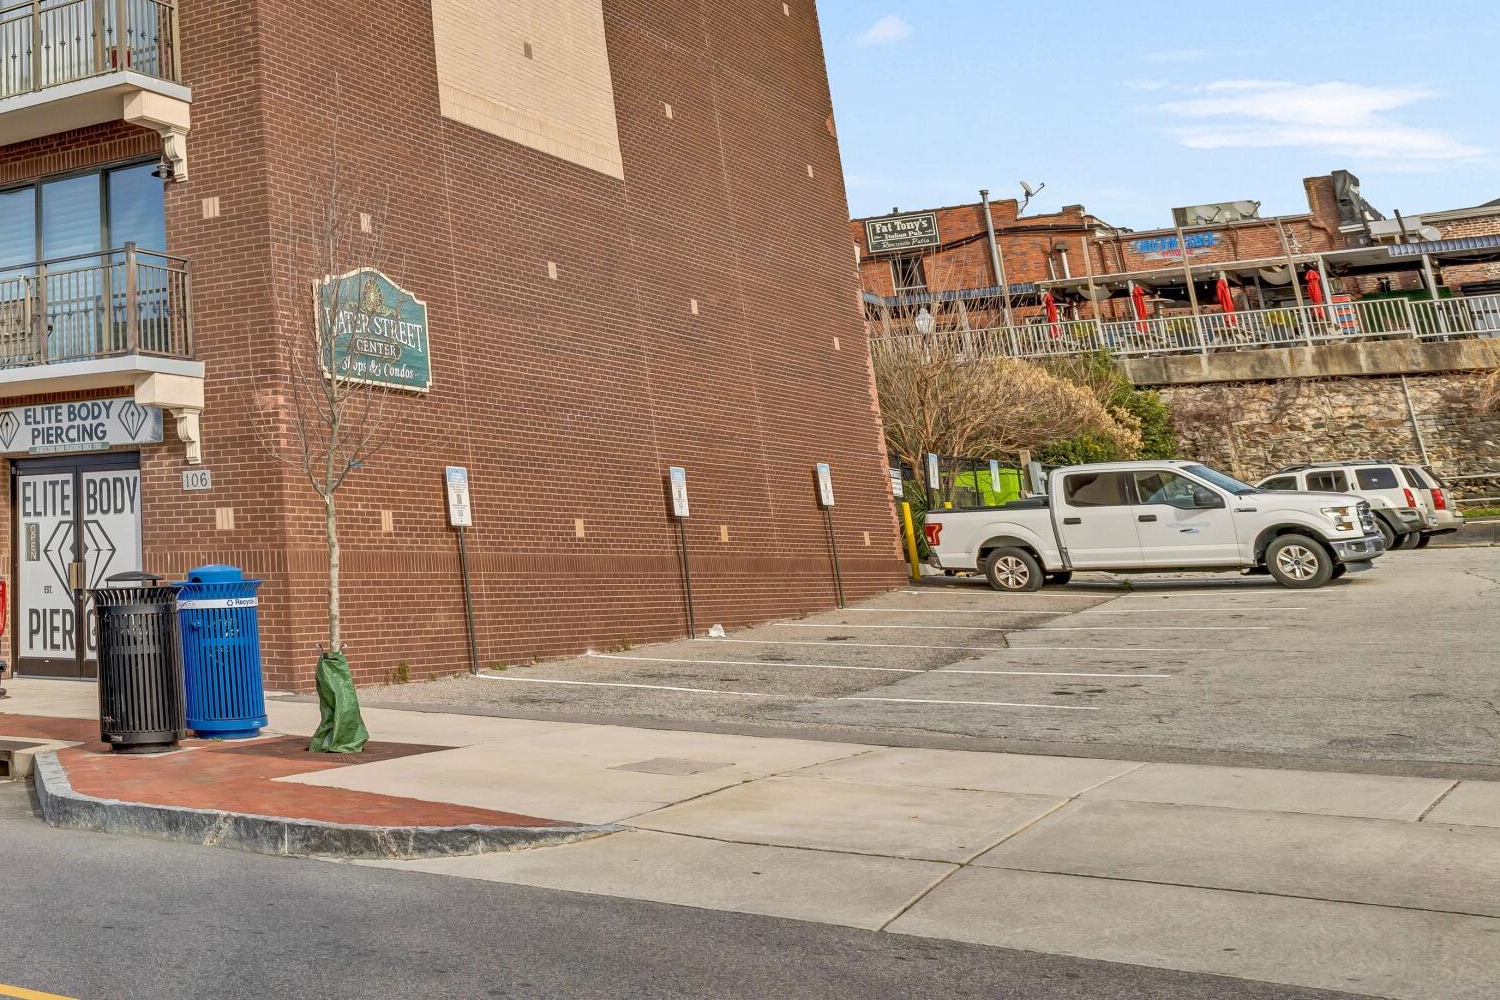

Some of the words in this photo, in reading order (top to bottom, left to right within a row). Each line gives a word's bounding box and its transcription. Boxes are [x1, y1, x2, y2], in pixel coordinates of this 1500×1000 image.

[875, 223, 893, 233] Fat
[894, 219, 928, 231] Tony's
[884, 232, 907, 240] Italian
[373, 316, 423, 353] STREET
[356, 339, 397, 357] CENTER
[369, 359, 381, 377] &
[384, 362, 414, 379] Condos
[24, 405, 63, 426] ELITE
[67, 401, 114, 422] BODY
[31, 422, 107, 446] PIERCING
[185, 472, 208, 488] 106
[21, 479, 71, 517] ELITE
[86, 476, 138, 516] BODY
[28, 608, 98, 652] PIERC
